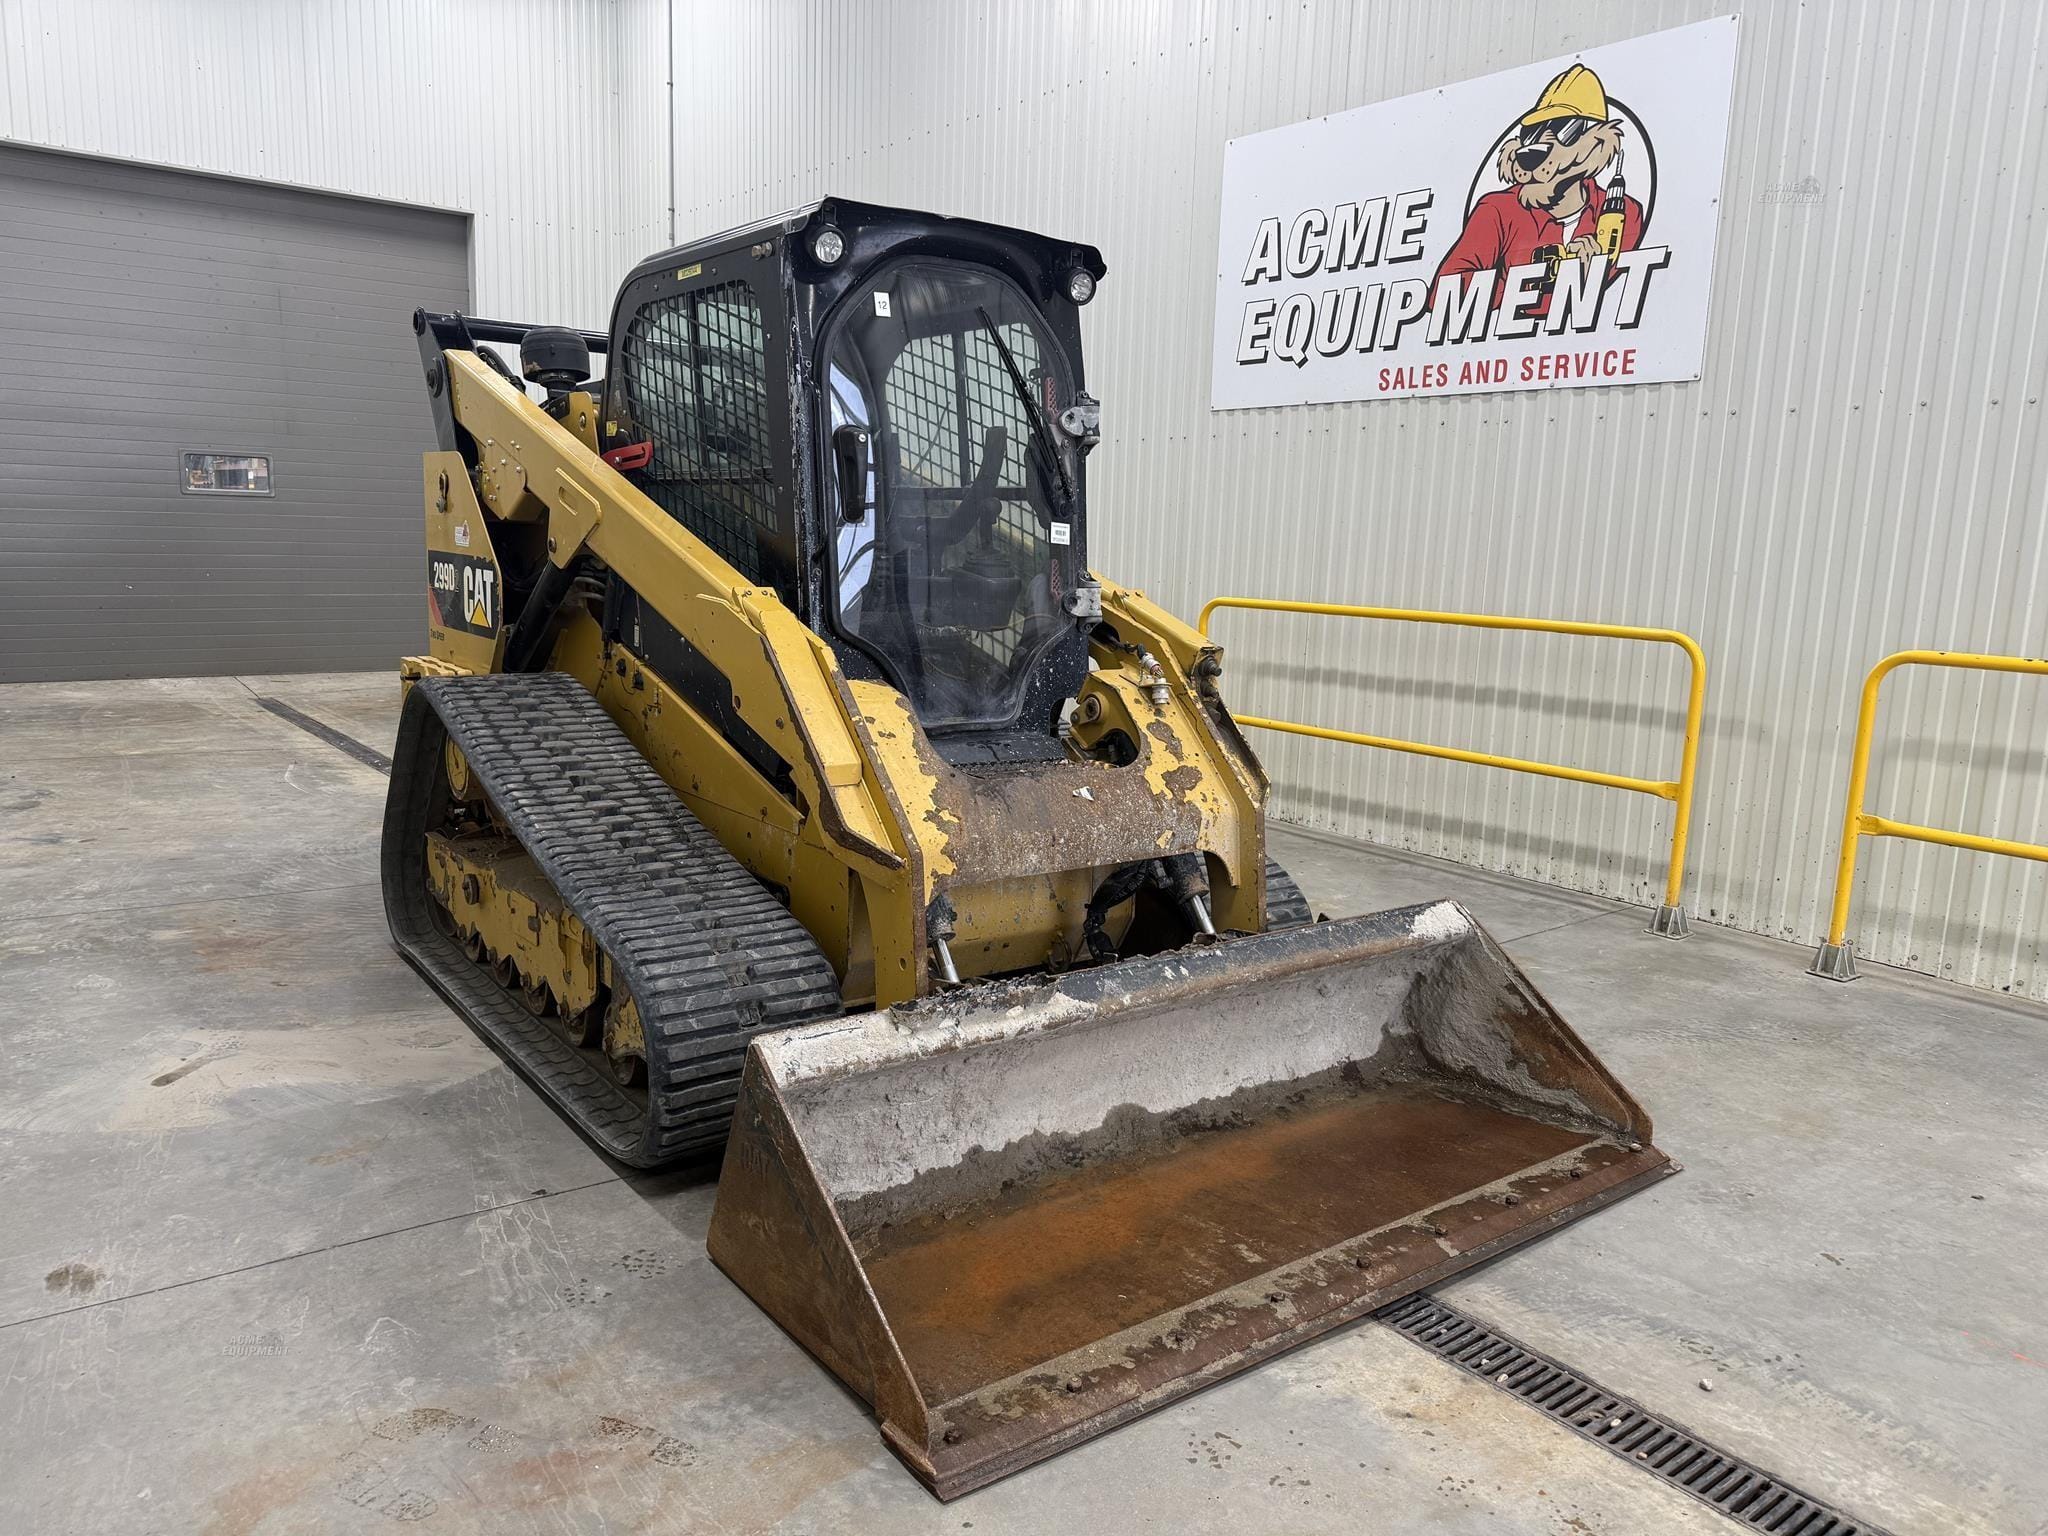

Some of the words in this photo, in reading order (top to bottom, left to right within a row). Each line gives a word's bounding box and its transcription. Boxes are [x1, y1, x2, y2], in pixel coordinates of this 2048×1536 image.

[1241, 187, 1435, 286] ACME
[878, 300, 888, 310] 12
[1236, 245, 1673, 369] EQUIPMENT
[1378, 363, 1449, 391] SALES
[1458, 358, 1509, 386] AND
[1520, 349, 1637, 382] SERVICE
[433, 561, 455, 591] 299D
[463, 565, 494, 629] CAT
